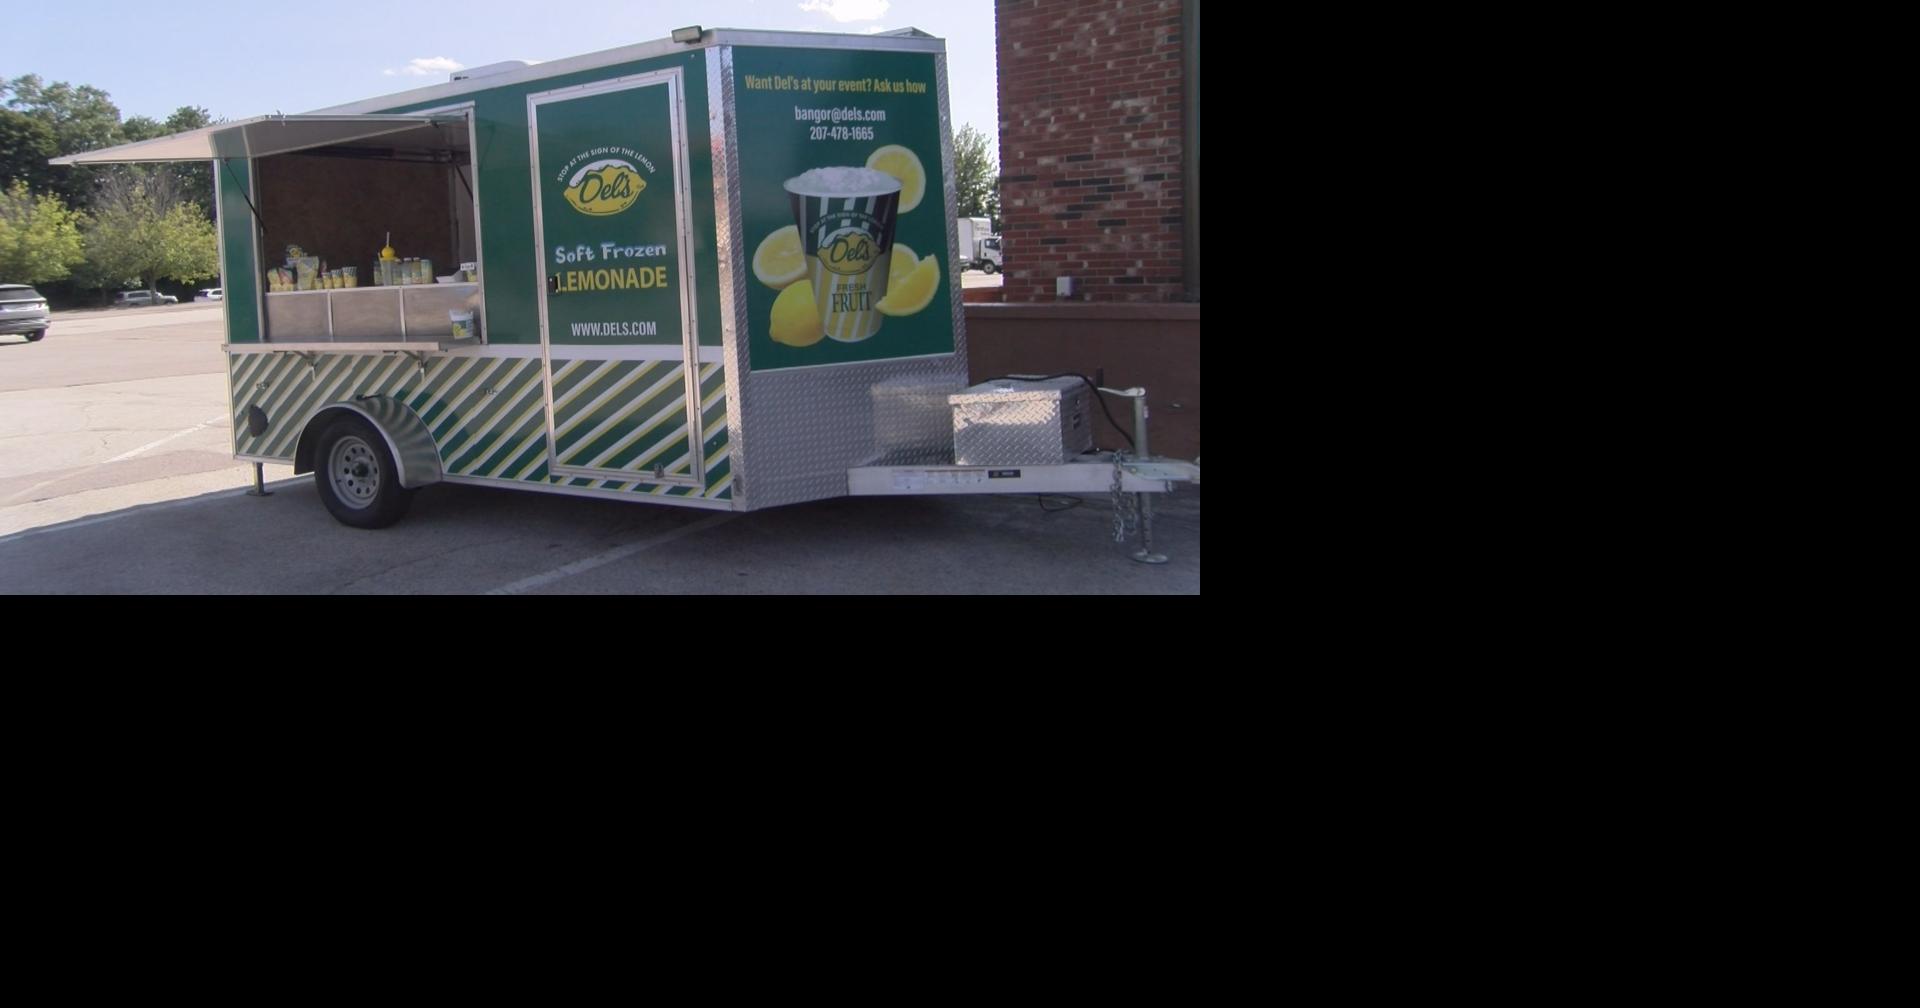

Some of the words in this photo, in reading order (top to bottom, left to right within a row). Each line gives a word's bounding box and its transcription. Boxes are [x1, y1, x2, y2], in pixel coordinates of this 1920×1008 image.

[745, 75, 772, 90] Want
[774, 76, 799, 91] Del's
[801, 78, 811, 91] at
[813, 79, 836, 94] your
[838, 79, 871, 92] event?
[873, 79, 892, 93] Ask
[893, 81, 905, 93] us
[906, 80, 926, 94] how
[795, 106, 886, 123] bangor@dels.com
[810, 126, 874, 140] 207-478-1665
[557, 165, 570, 182] STOP
[569, 158, 577, 167] AT
[577, 151, 590, 161] THE
[590, 147, 608, 156] SIGN
[622, 147, 635, 157] THE
[635, 152, 656, 174] LEMON
[580, 172, 633, 203] Del's
[555, 245, 595, 264] Soft
[601, 242, 667, 261] Frozen
[556, 266, 668, 292] LEMONADE
[832, 291, 872, 312] FRUIT
[571, 321, 657, 337] WWW.DELS.COM
